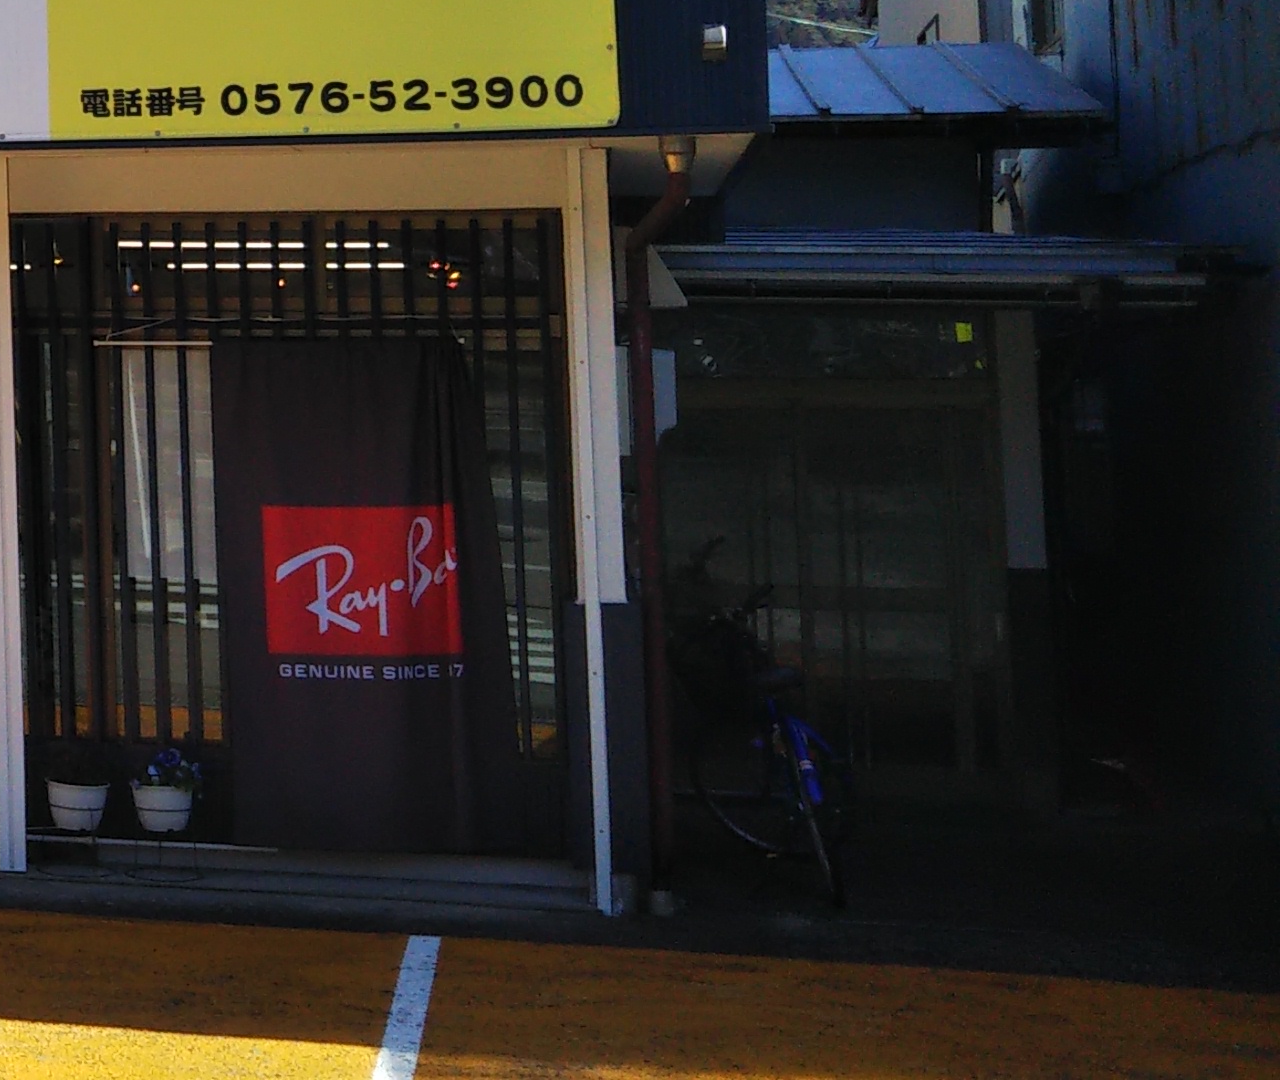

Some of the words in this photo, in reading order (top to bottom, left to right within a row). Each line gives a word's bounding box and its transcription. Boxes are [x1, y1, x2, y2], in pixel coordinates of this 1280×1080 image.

[80, 86, 206, 117] 電話番号
[220, 74, 584, 115] 0576-52-3900
[279, 663, 375, 680] GENUINE
[382, 664, 440, 680] SINCE
